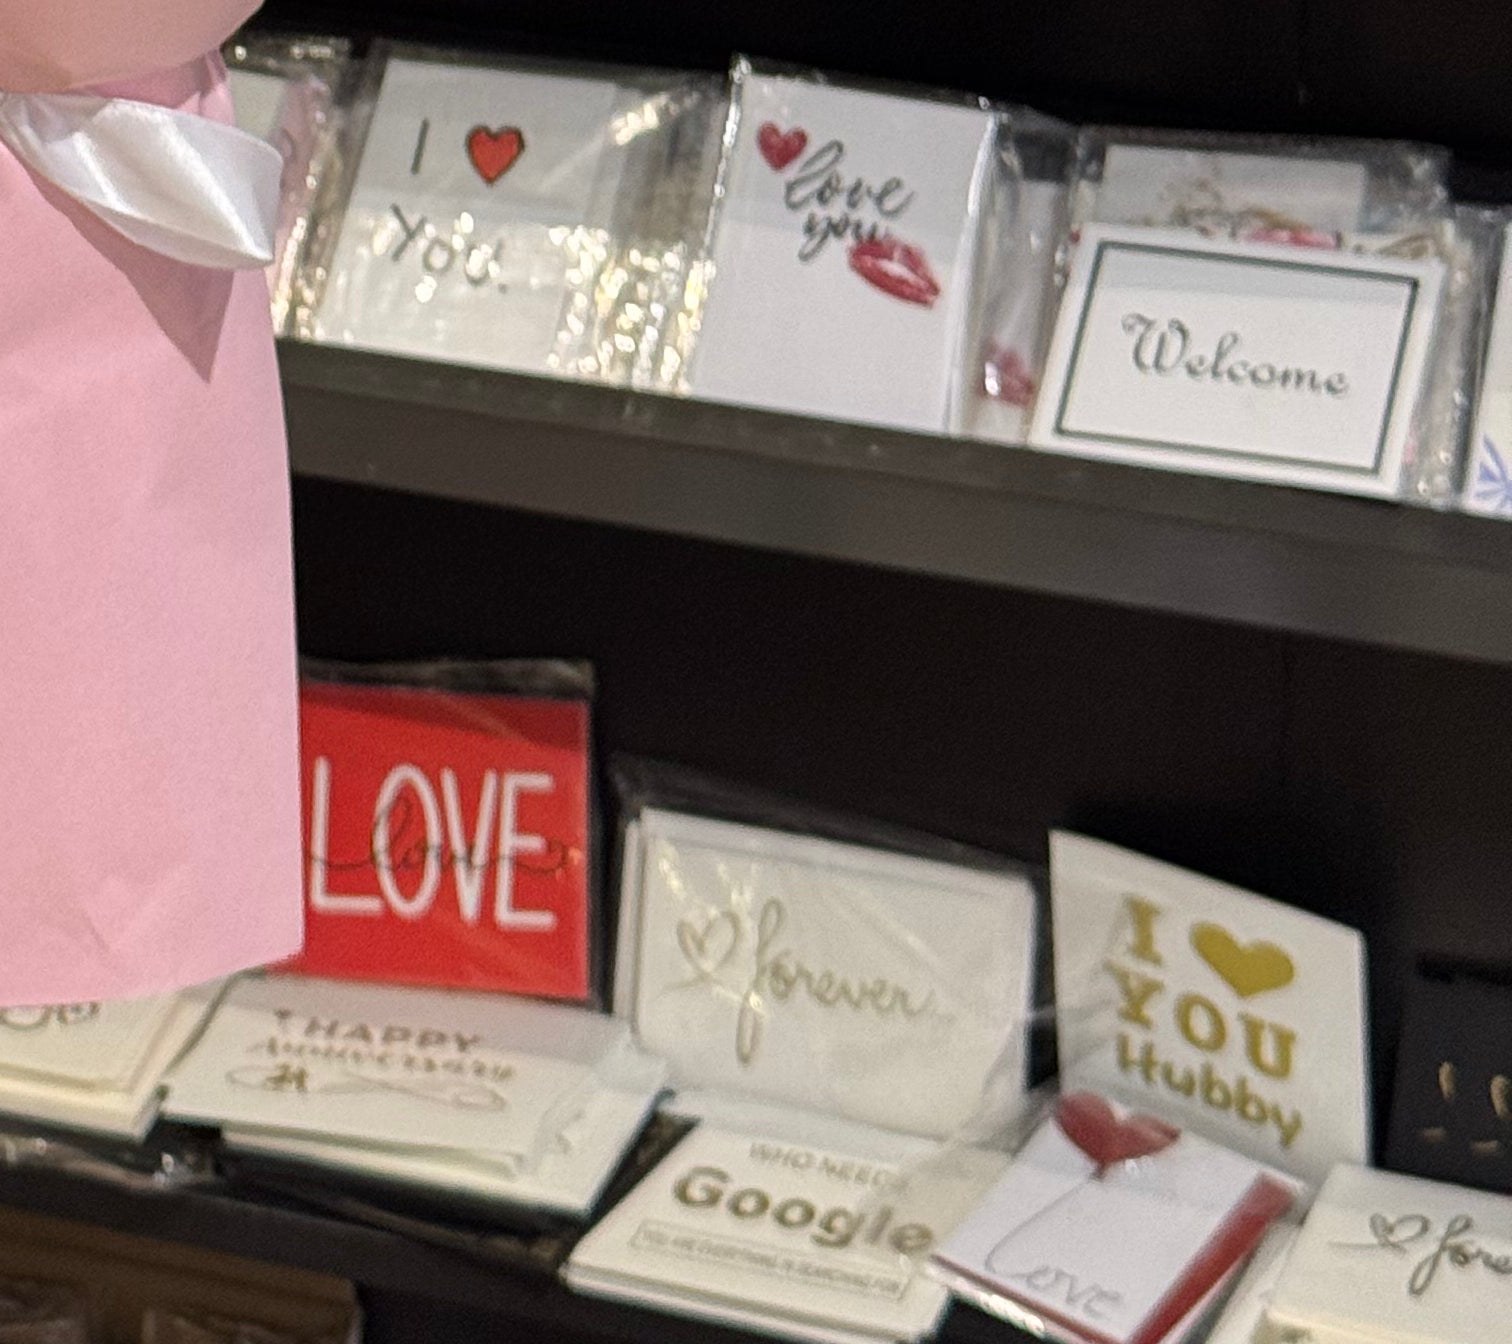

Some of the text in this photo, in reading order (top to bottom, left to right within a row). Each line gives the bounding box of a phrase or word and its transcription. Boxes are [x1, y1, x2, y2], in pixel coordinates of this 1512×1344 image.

[410, 117, 429, 175] I
[786, 139, 914, 212] love
[798, 208, 892, 262] you
[1121, 311, 1350, 398] Welcome
[310, 756, 558, 930] LOVE
[1122, 893, 1162, 967] I
[737, 898, 935, 1064] forever
[1105, 960, 1298, 1079] YOU
[1117, 1034, 1303, 1149] Hubby
[672, 1165, 936, 1254] Google
